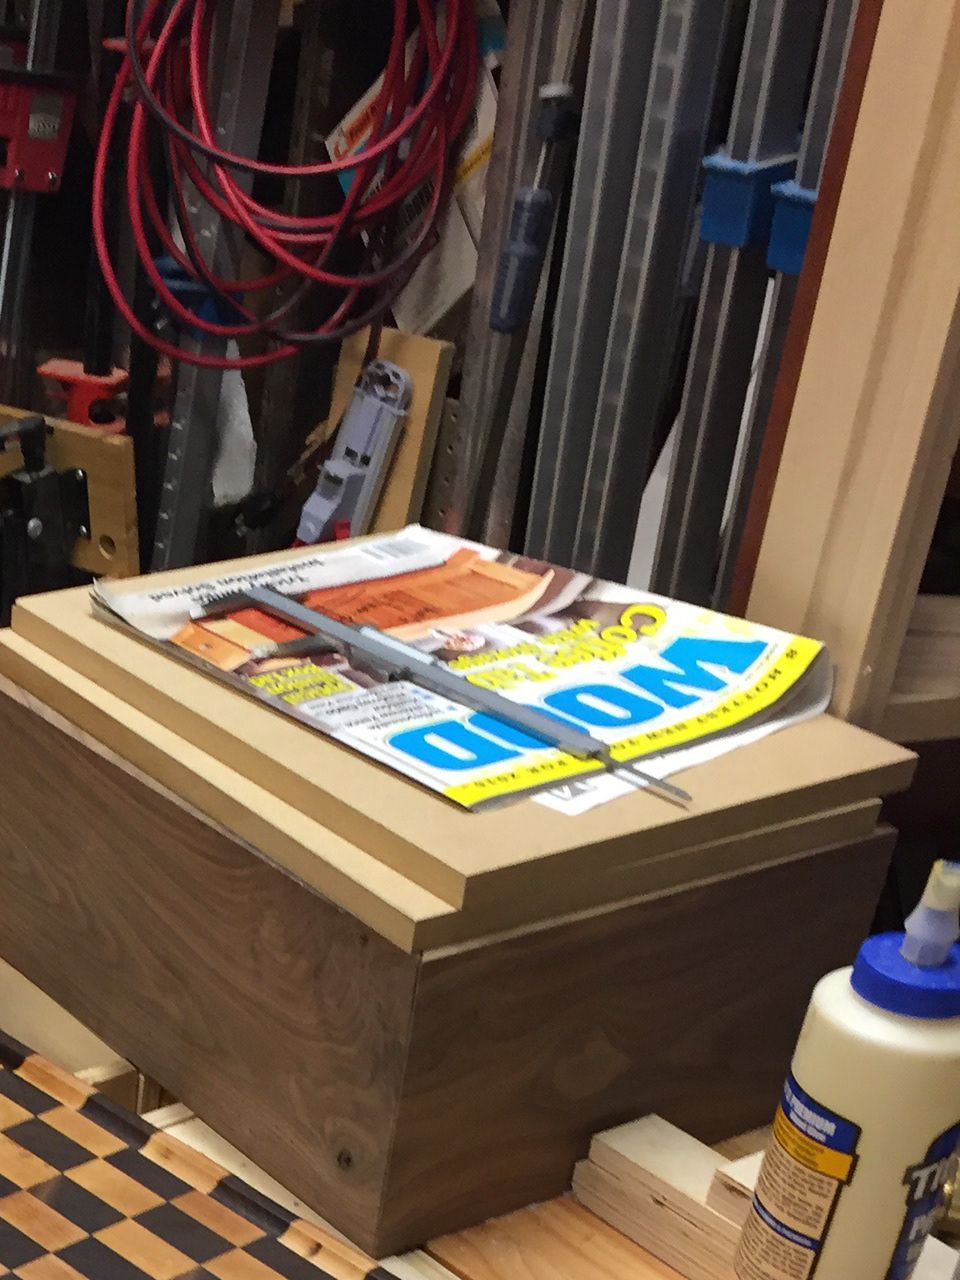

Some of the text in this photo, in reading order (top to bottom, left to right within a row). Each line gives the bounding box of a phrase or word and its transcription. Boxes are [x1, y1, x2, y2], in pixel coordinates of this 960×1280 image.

[466, 603, 668, 690] Coffee Tab
[388, 636, 769, 772] WOOD
